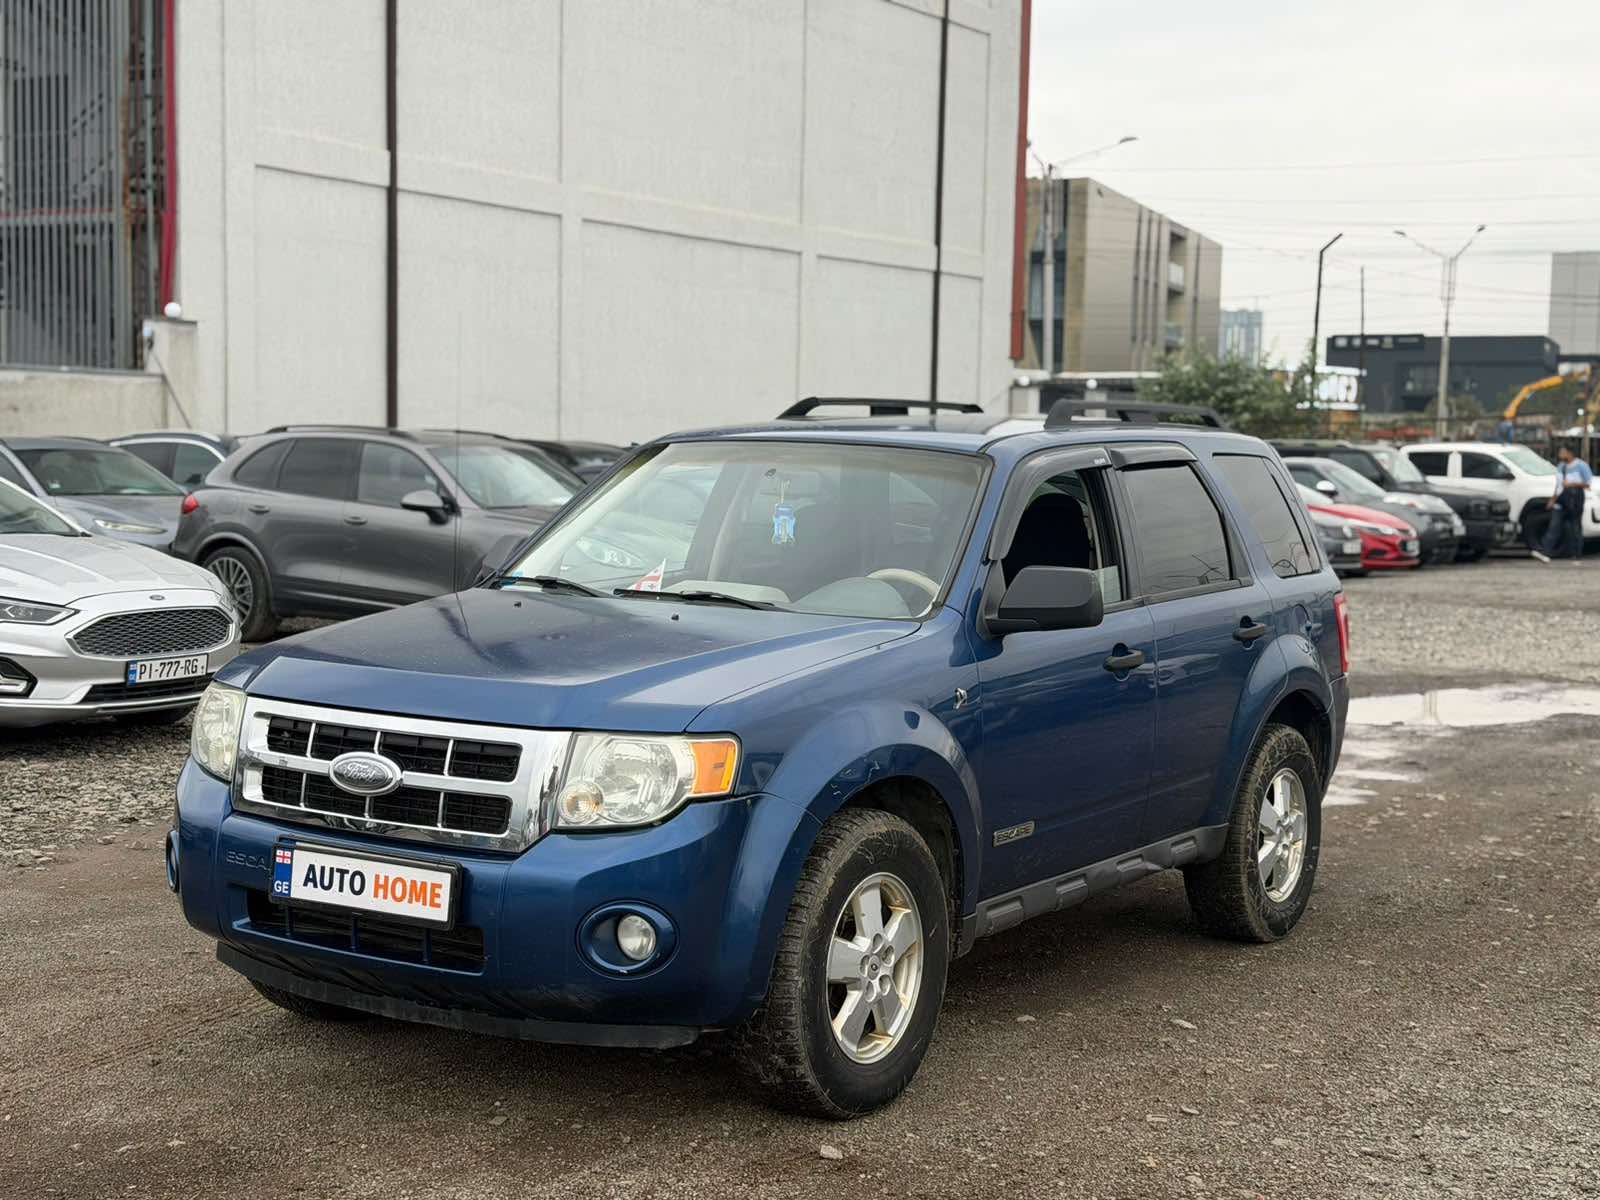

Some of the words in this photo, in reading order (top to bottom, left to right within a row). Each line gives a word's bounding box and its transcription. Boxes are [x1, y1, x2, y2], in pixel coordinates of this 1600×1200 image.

[138, 658, 199, 680] PI-777-RG
[226, 850, 269, 871] ESCA
[274, 880, 289, 894] GE
[302, 863, 366, 896] AUTO
[373, 873, 443, 909] HOME
